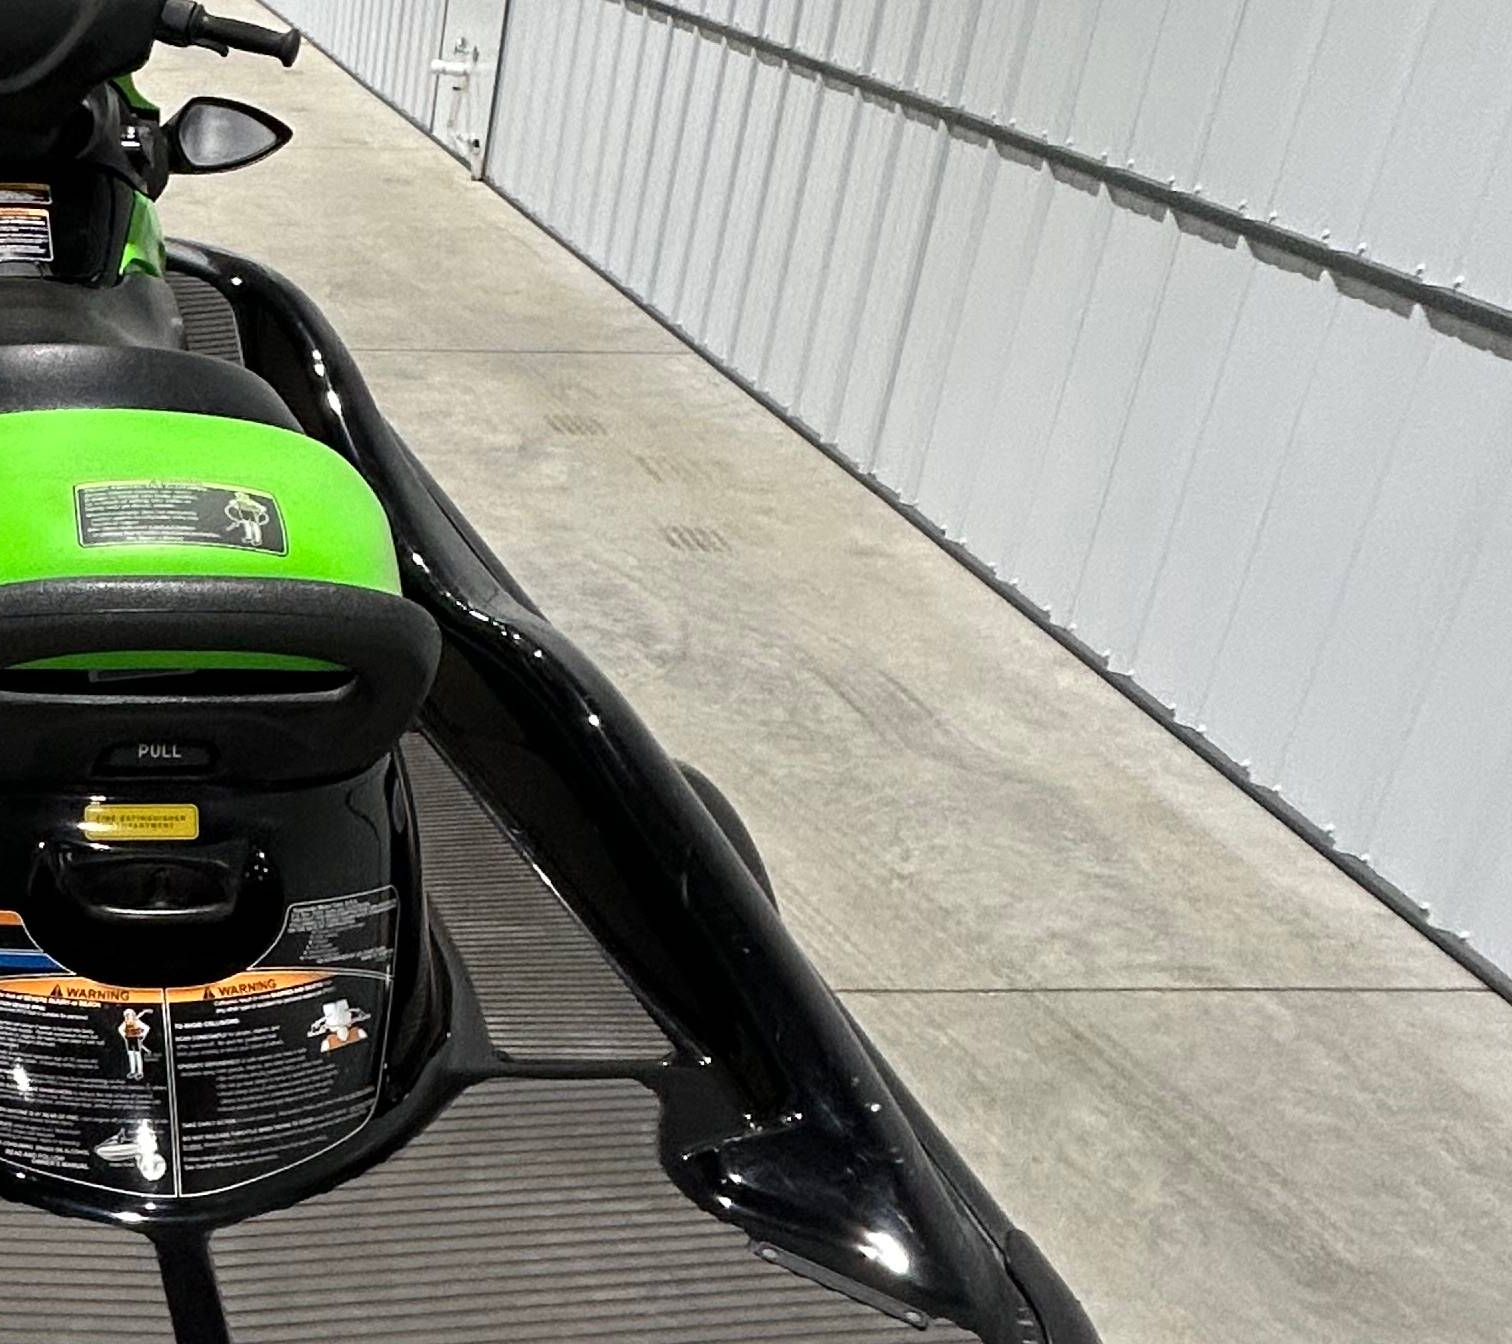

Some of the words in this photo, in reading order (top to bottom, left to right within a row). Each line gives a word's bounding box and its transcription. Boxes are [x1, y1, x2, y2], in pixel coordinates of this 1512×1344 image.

[138, 744, 182, 758] PULL
[66, 986, 130, 1001] WARNING
[216, 978, 277, 997] WARNING
